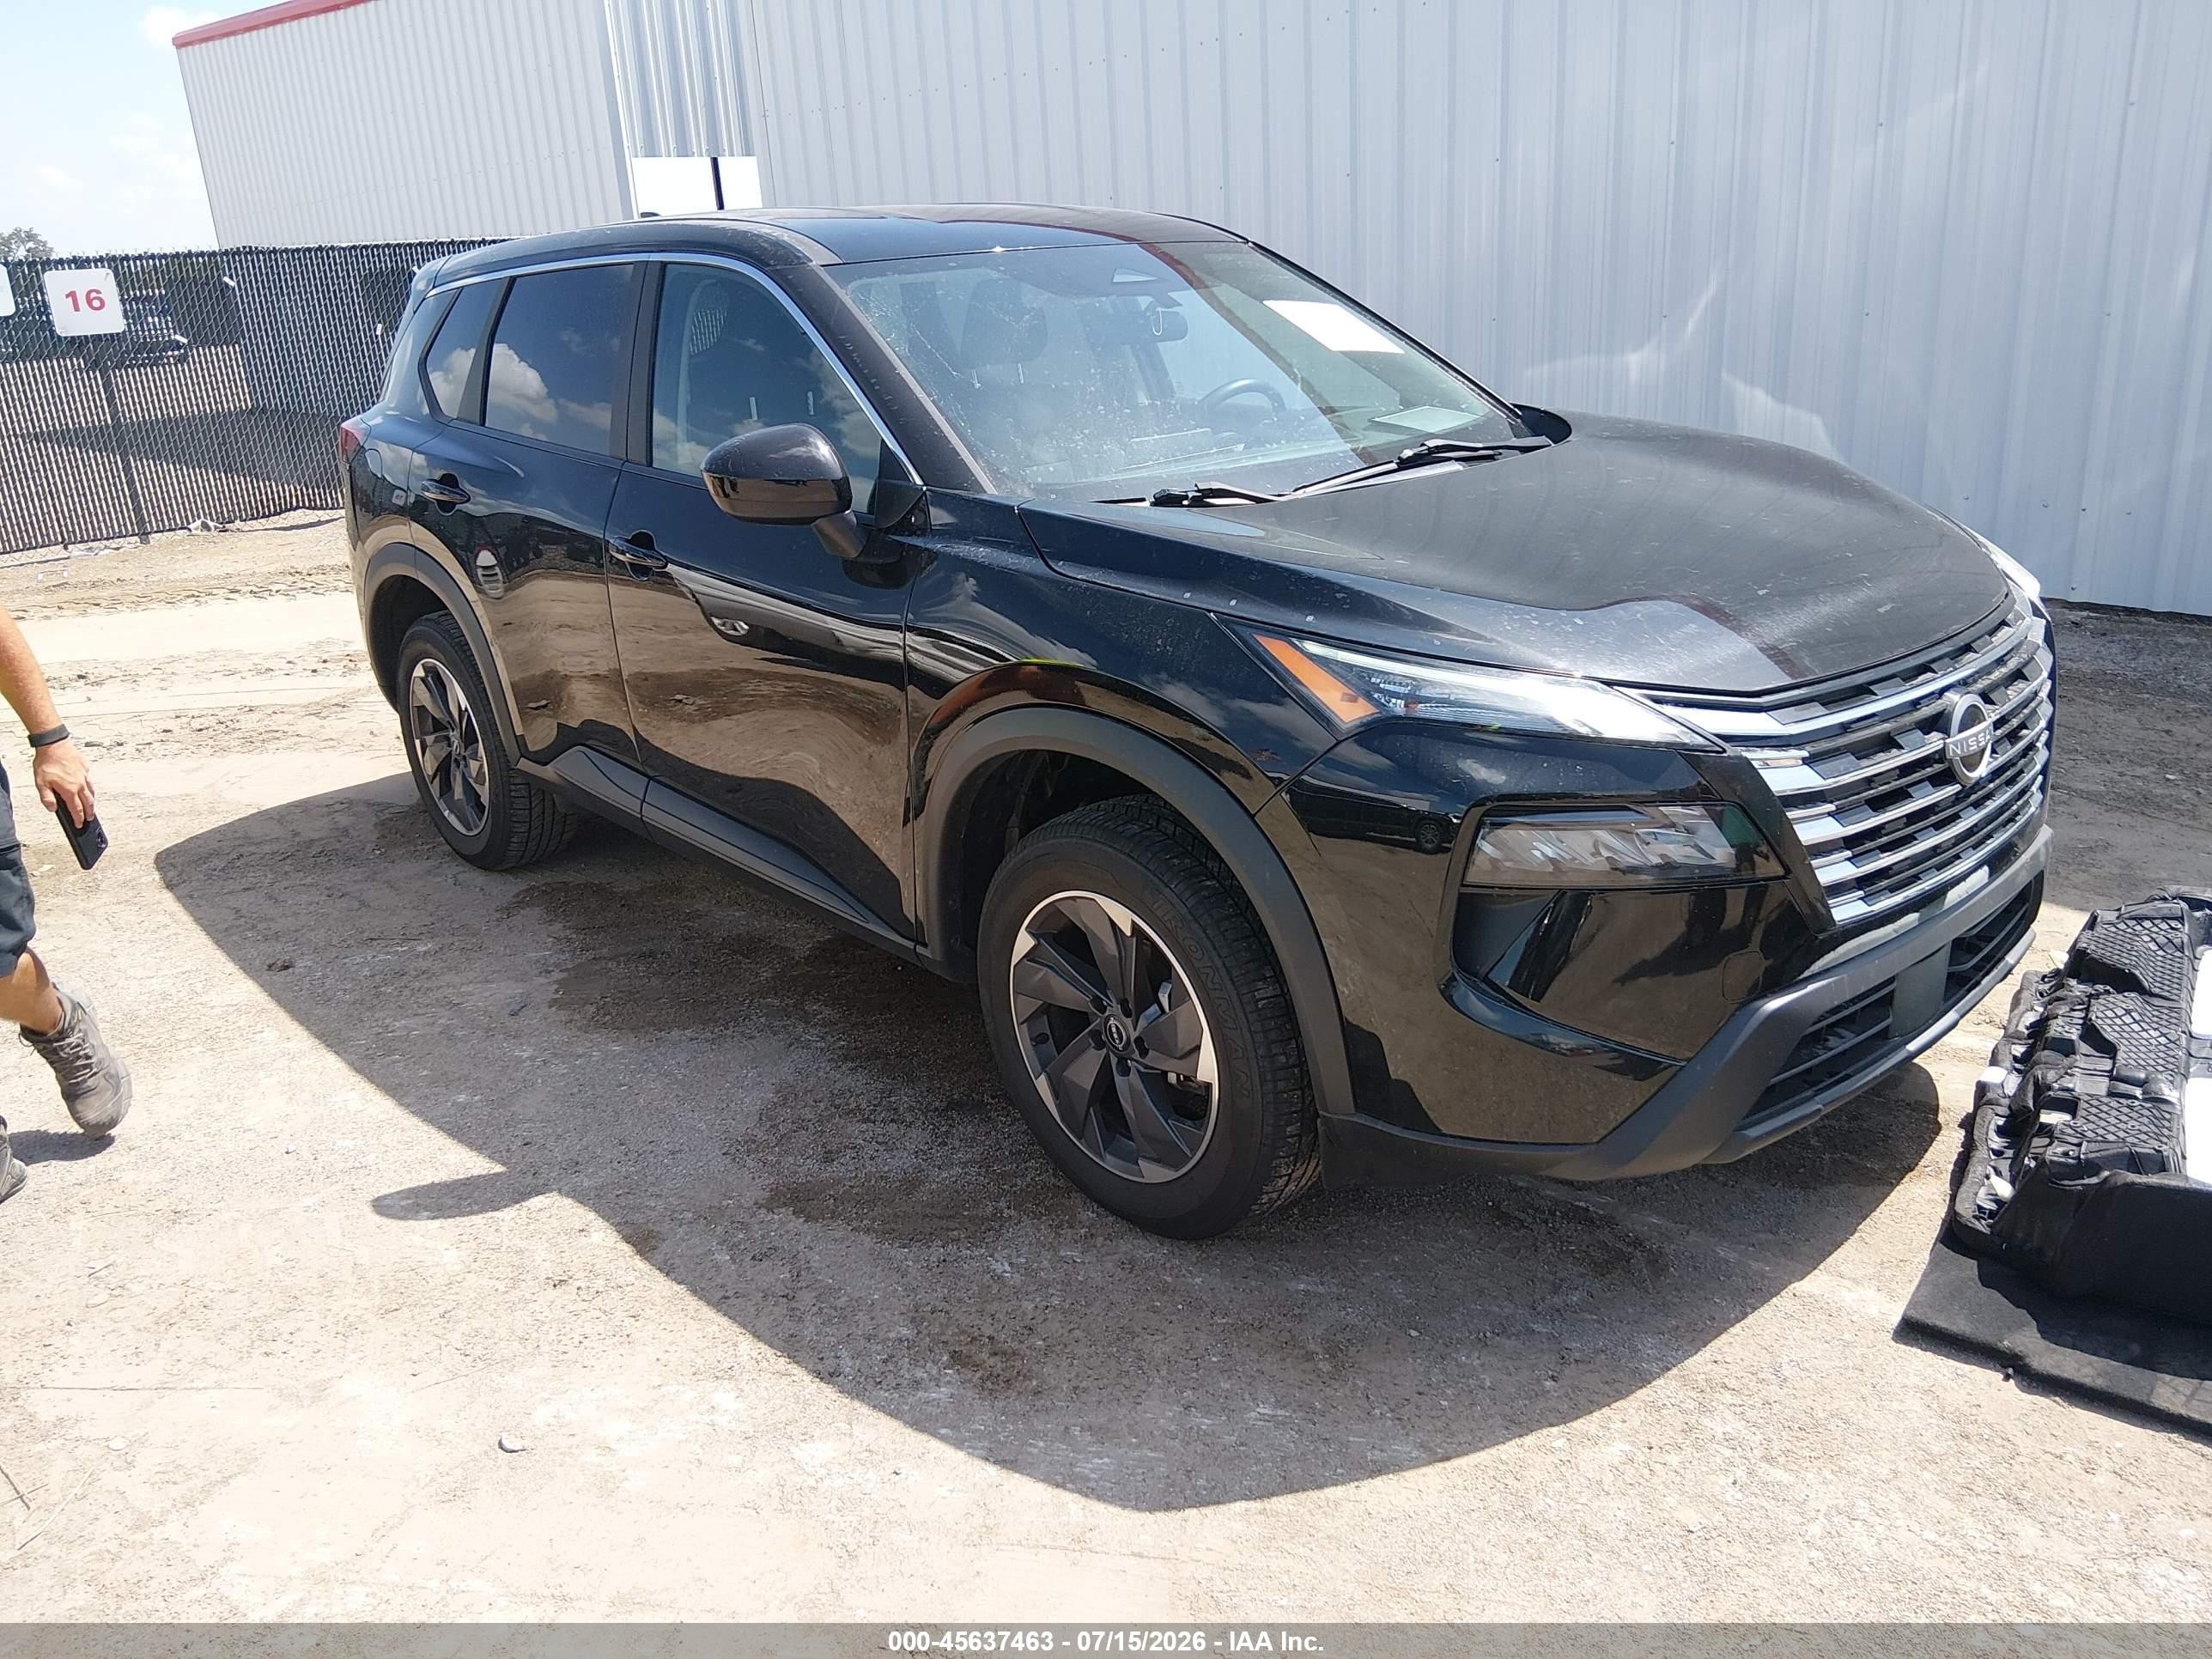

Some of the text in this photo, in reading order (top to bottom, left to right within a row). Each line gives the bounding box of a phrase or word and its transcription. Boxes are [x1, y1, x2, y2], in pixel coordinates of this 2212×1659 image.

[64, 289, 106, 313] 16
[1949, 727, 1992, 757] NISSA
[1151, 896, 1253, 1101] IRONMAN
